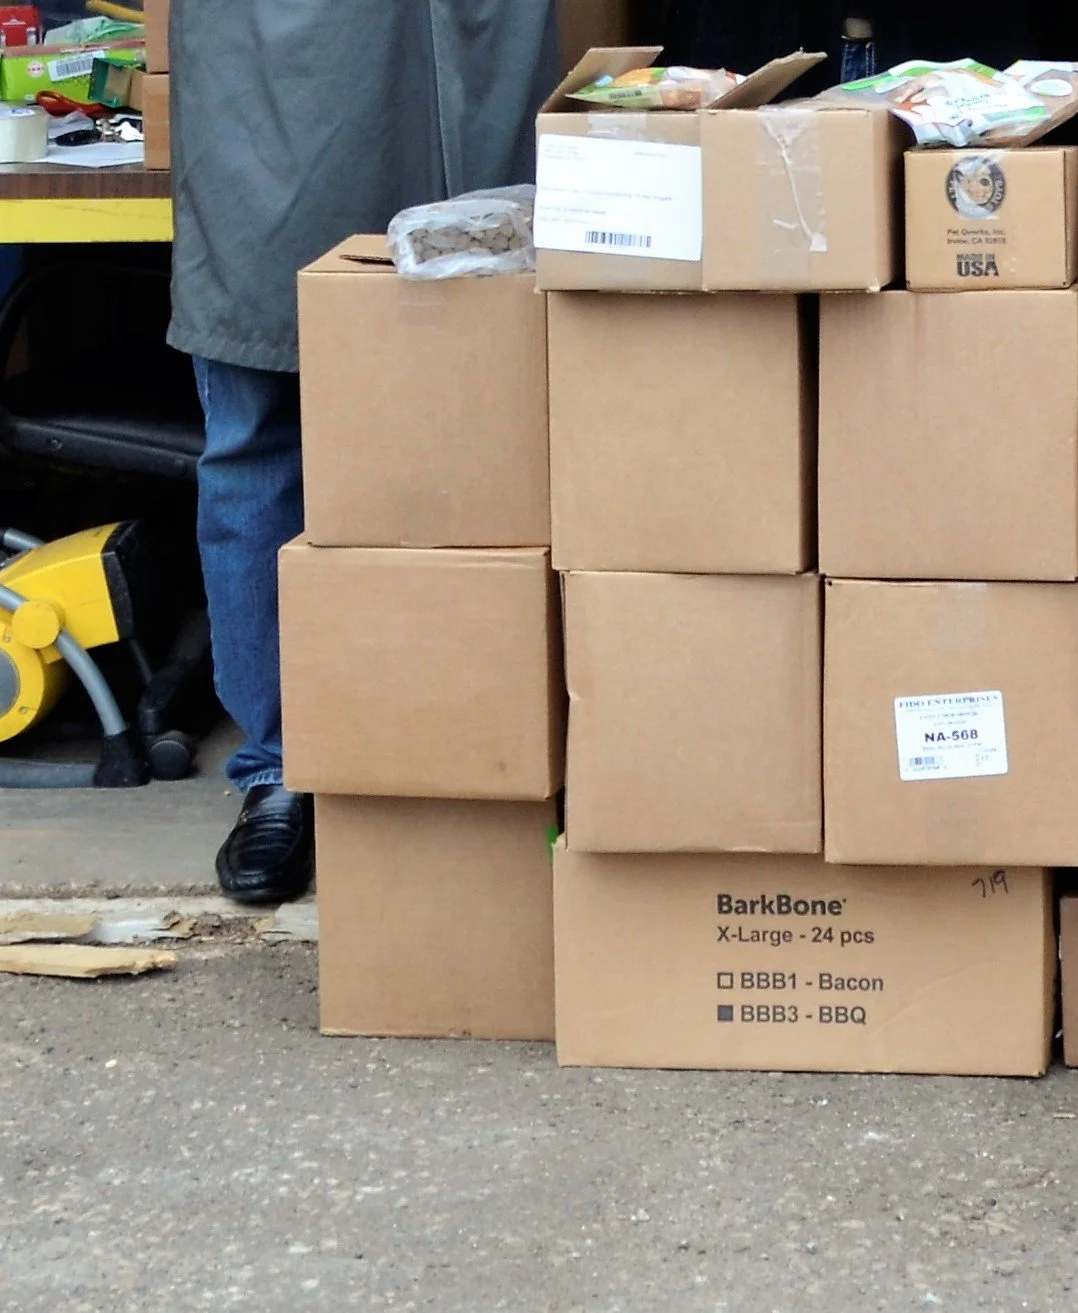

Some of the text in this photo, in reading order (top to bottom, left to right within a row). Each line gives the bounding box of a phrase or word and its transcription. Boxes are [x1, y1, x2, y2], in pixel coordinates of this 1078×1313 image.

[956, 253, 996, 261] MADE IN
[956, 261, 999, 277] USA
[924, 729, 979, 743] NA-568
[717, 893, 844, 916] BarkBone
[717, 926, 793, 947] X-Large
[811, 927, 834, 944] 24
[840, 929, 875, 948] pcs
[740, 972, 797, 989] BBB1
[818, 973, 884, 991] Bacon
[740, 1005, 799, 1023] BBB3
[818, 1006, 867, 1025] BBQ
